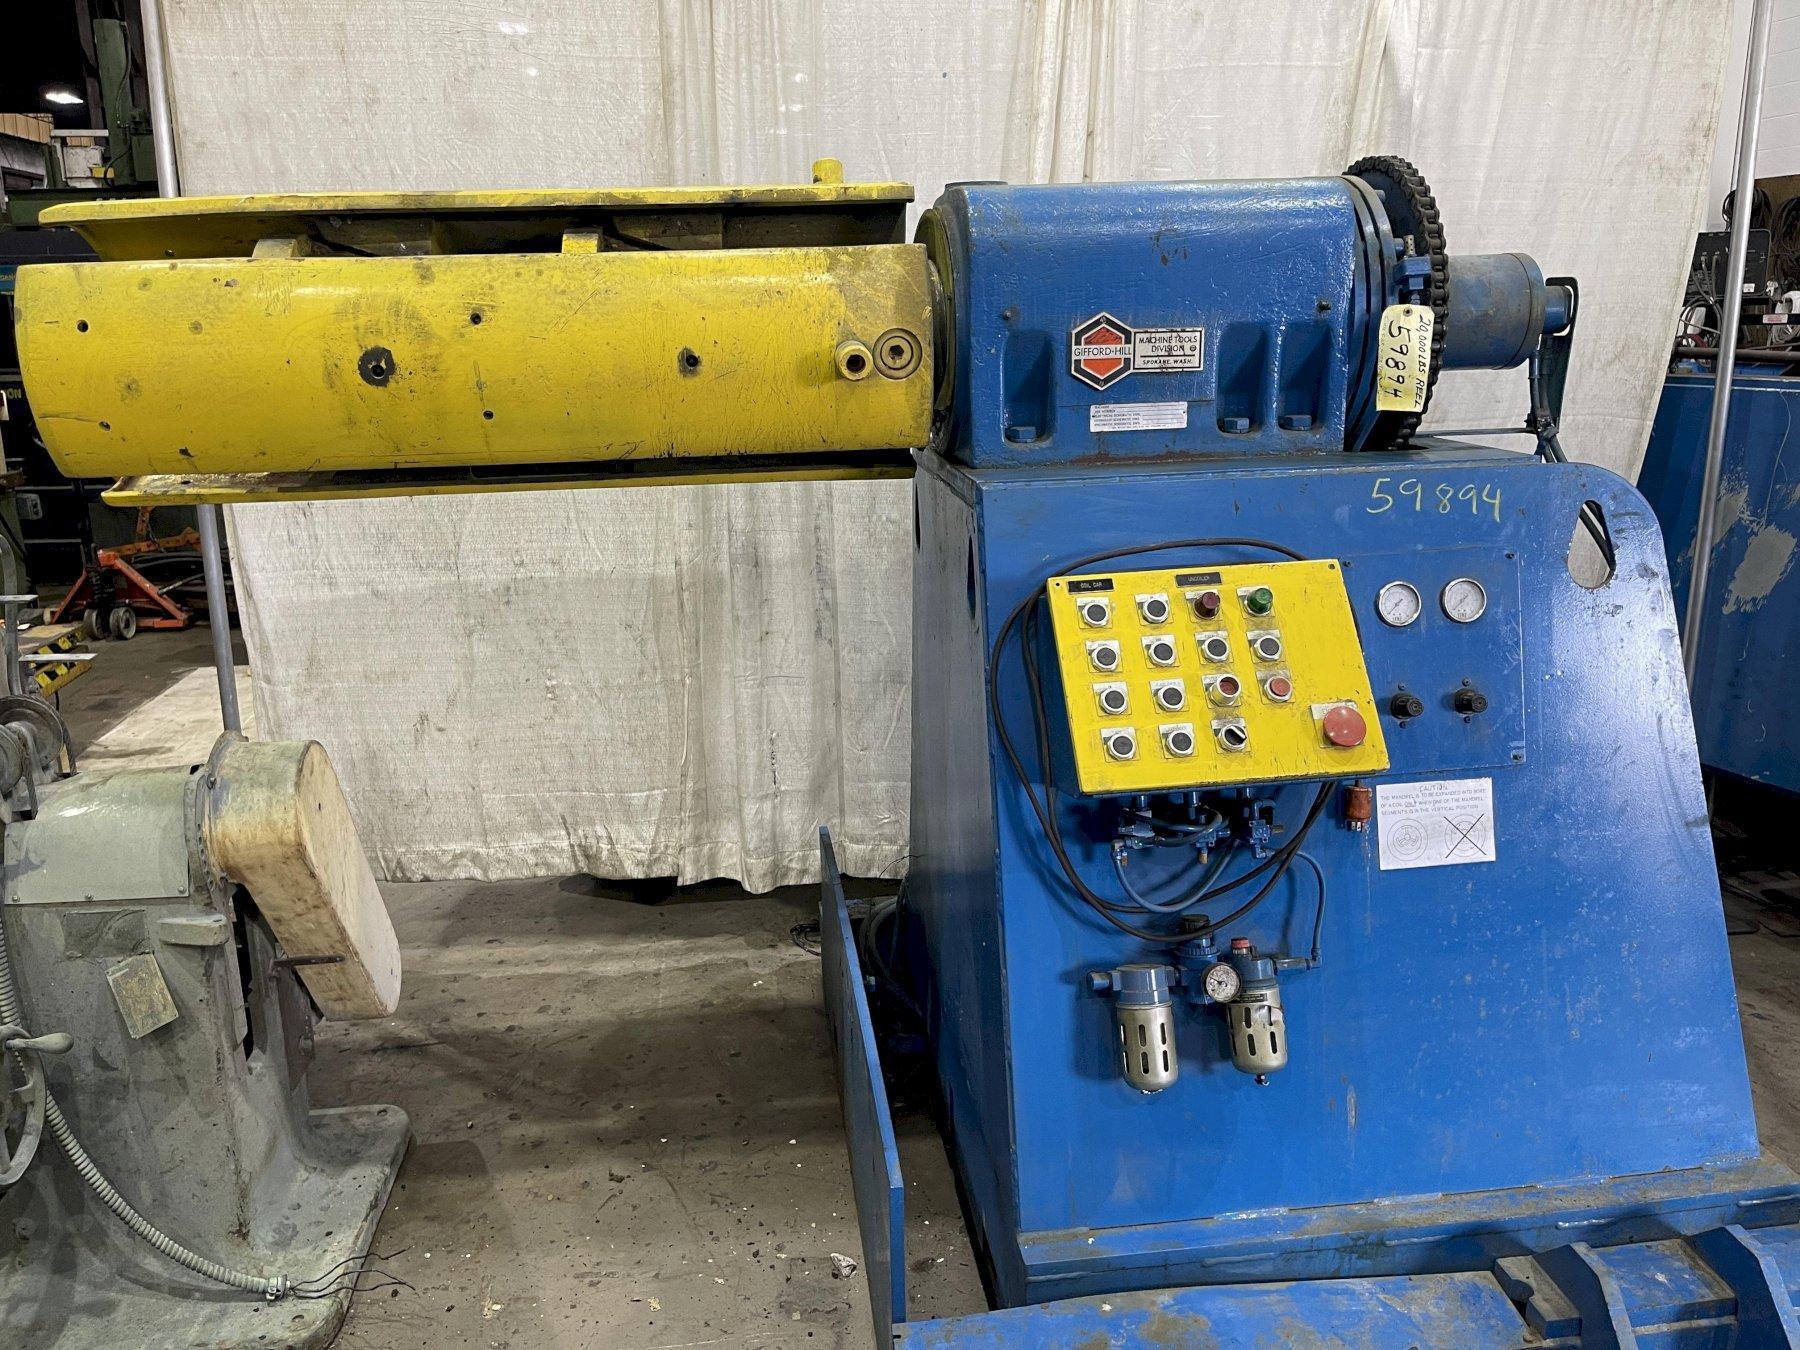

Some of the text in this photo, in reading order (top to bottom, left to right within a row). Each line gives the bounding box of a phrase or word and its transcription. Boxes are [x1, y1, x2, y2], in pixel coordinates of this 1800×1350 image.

[1138, 335, 1198, 344] MACHINE TOOLS
[1073, 346, 1132, 357] GIFFORD-HILL
[1151, 344, 1185, 353] DIVISION
[1384, 319, 1411, 398] 59894
[1414, 378, 1425, 408] REEL
[1366, 477, 1500, 523] 59894
[1419, 784, 1448, 792] CAUTION
